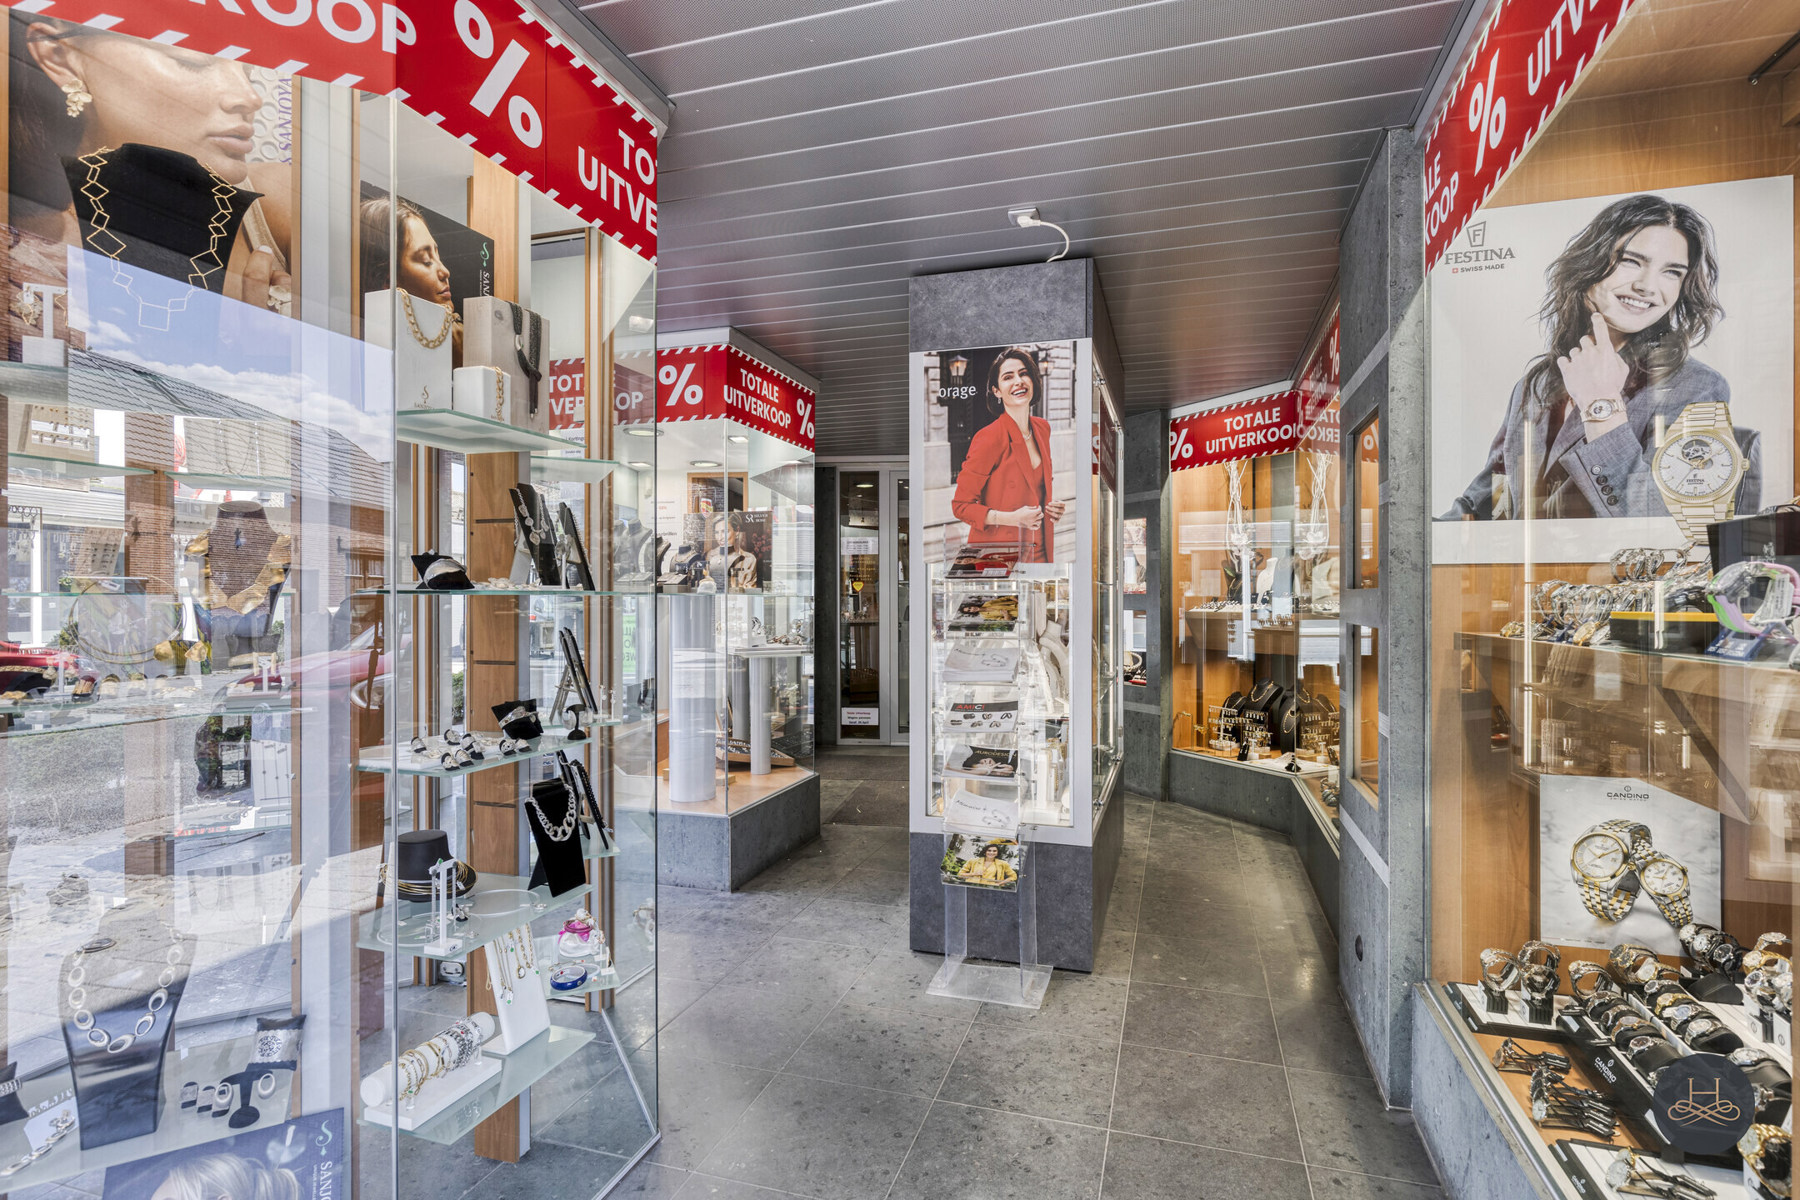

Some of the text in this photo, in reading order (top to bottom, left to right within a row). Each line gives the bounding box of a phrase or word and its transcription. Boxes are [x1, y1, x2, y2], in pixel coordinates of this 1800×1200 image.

[1528, 0, 1600, 96] UITV
[454, 0, 543, 149] %
[1469, 48, 1507, 177] %
[618, 129, 657, 185] TO
[1444, 247, 1517, 265] FESTINA
[1460, 263, 1505, 273] SWISS MADE
[658, 363, 704, 407] %
[740, 368, 779, 404] TOTALE
[938, 386, 976, 399] orage
[723, 384, 791, 430] UITVERKOOP
[796, 398, 815, 440] %
[1224, 407, 1281, 433] TOTALE
[1169, 428, 1193, 461] %
